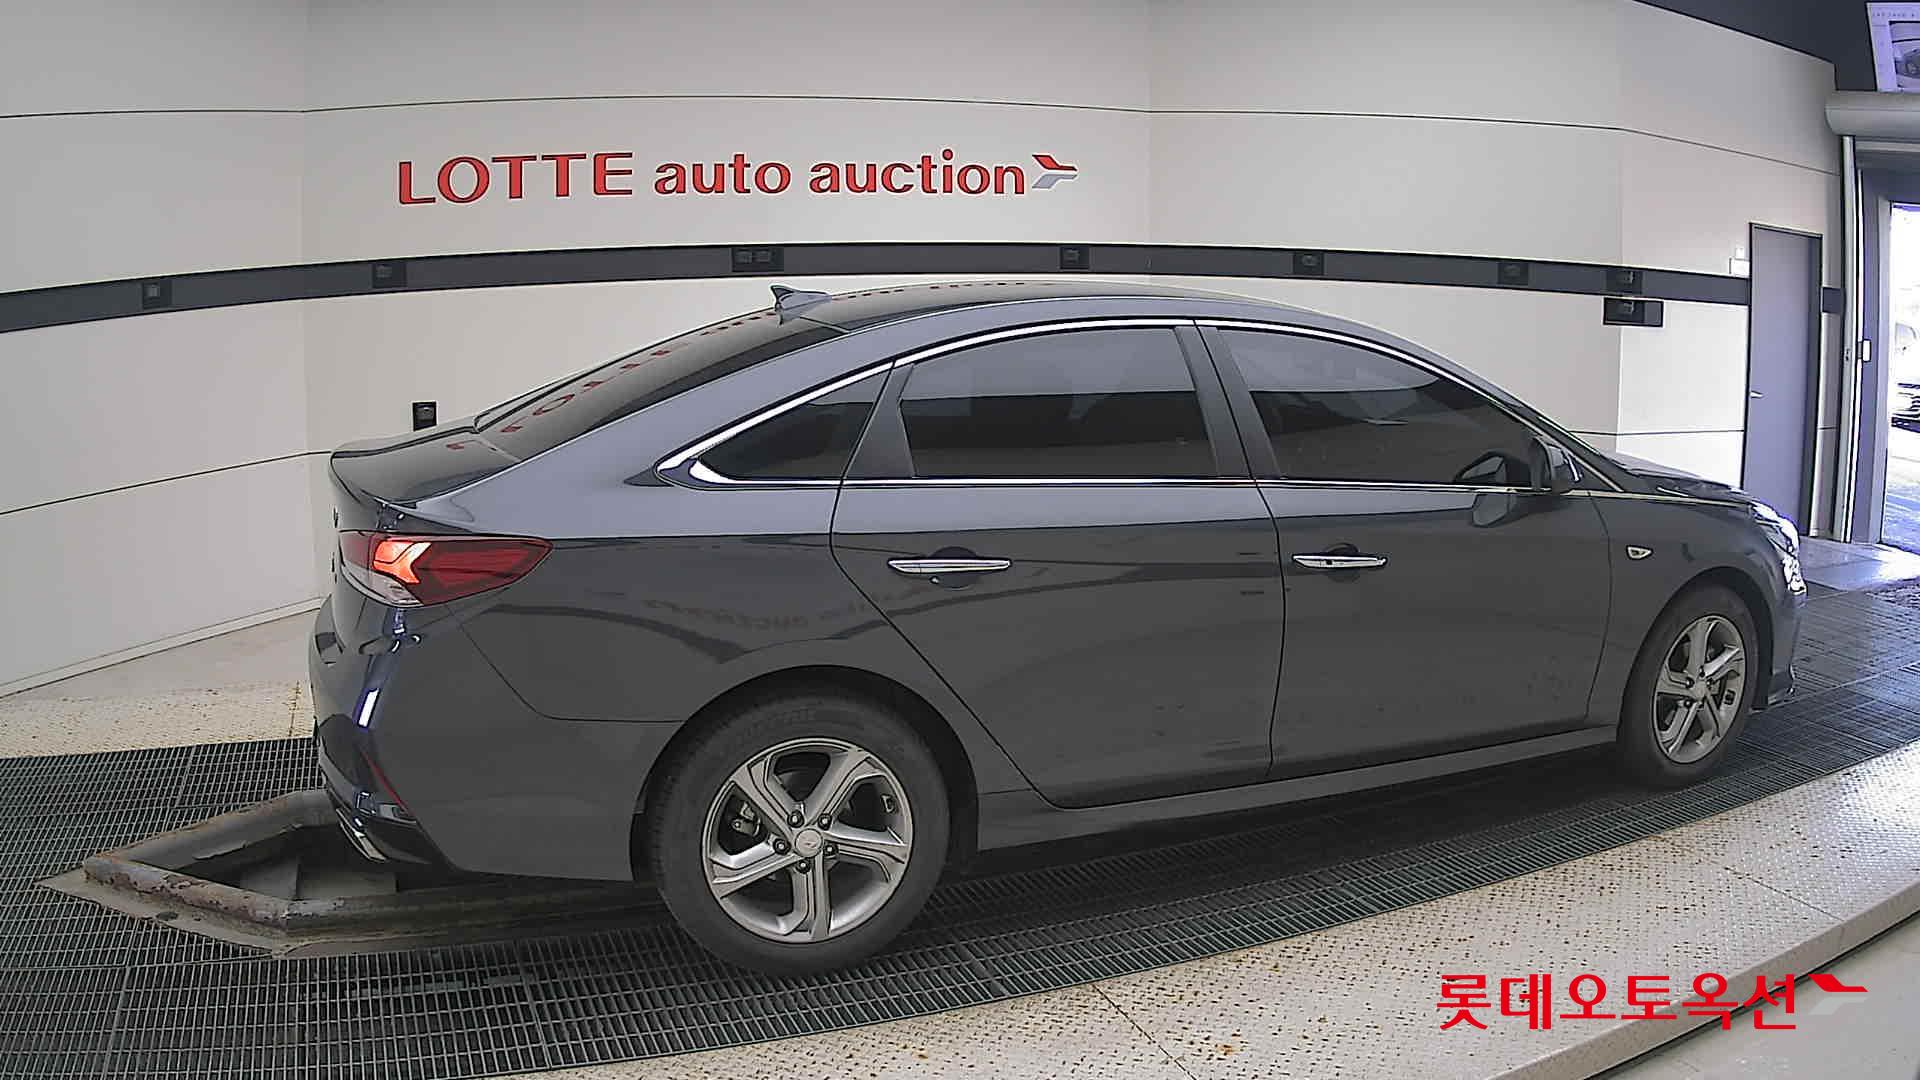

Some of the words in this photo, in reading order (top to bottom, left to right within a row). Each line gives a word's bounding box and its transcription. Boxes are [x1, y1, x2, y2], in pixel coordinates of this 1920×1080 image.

[399, 152, 633, 205] LOTTE
[655, 152, 791, 195] auto
[809, 149, 1025, 195] auction
